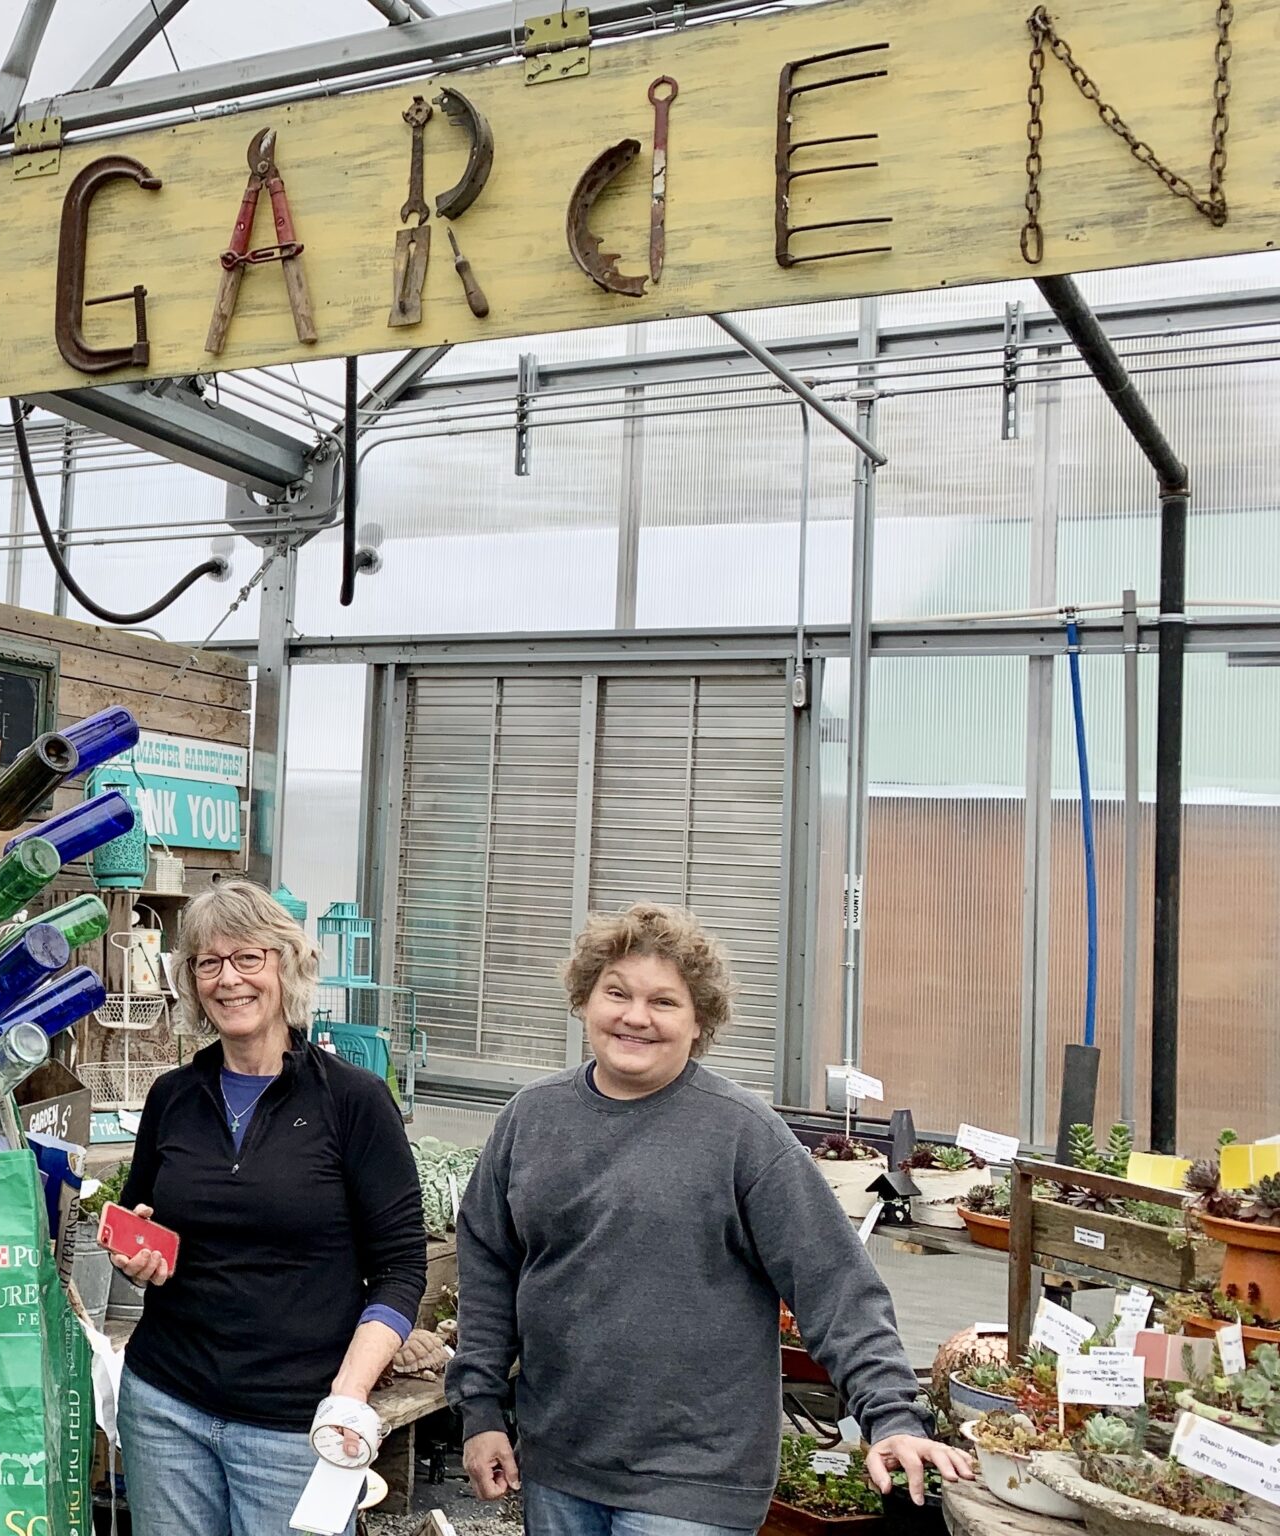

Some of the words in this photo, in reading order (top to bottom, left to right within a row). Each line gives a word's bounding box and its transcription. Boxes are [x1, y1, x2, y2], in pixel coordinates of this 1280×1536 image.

[136, 738, 181, 769] MASTER
[184, 747, 243, 777] GARDENERS!
[186, 793, 238, 844] YOU!
[29, 1103, 61, 1133] GARDEN
